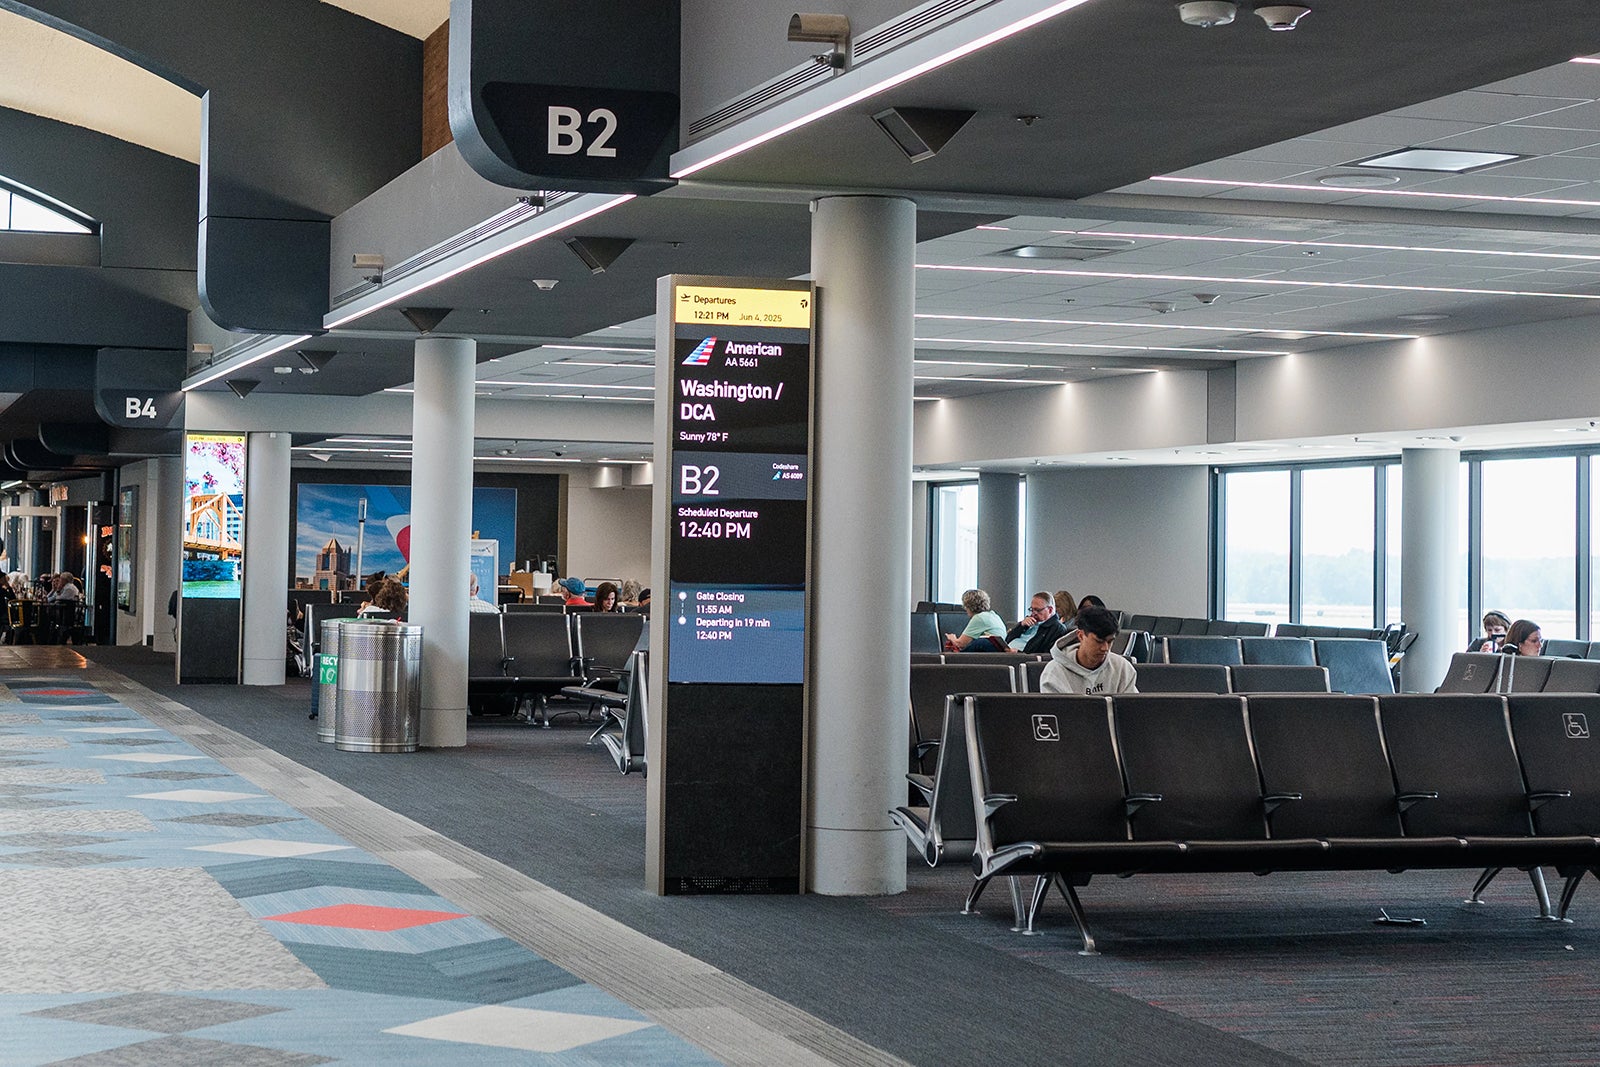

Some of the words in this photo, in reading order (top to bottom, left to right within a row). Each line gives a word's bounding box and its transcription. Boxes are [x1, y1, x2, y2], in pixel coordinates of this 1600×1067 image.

[548, 106, 617, 157] B2
[694, 295, 737, 305] Departures
[694, 311, 714, 320] 12:21
[716, 312, 729, 320] PM
[739, 313, 752, 321] Jun
[754, 314, 762, 322] 4,
[763, 314, 782, 322] 2025
[725, 341, 782, 356] American
[725, 358, 738, 367] AA
[739, 358, 758, 367] 5661
[680, 379, 772, 402] Washington
[774, 382, 784, 400] /
[126, 397, 157, 419] B4
[680, 403, 715, 421] DCA
[680, 431, 705, 443] Sunny
[706, 432, 721, 441] 78°
[722, 433, 729, 442] F
[681, 465, 720, 495] B2
[678, 507, 719, 517] Scheduled
[720, 508, 759, 519] Departure
[680, 521, 722, 538] 12:40
[725, 522, 751, 539] PM
[696, 592, 714, 600] Gate
[716, 592, 745, 603] Closing
[696, 605, 717, 614] 11:55
[719, 605, 733, 614] AM
[696, 617, 734, 628] Departing
[735, 618, 743, 627] in
[744, 618, 754, 627] 19
[755, 619, 771, 627] min
[696, 631, 718, 640] 12:40
[718, 631, 732, 640] PM
